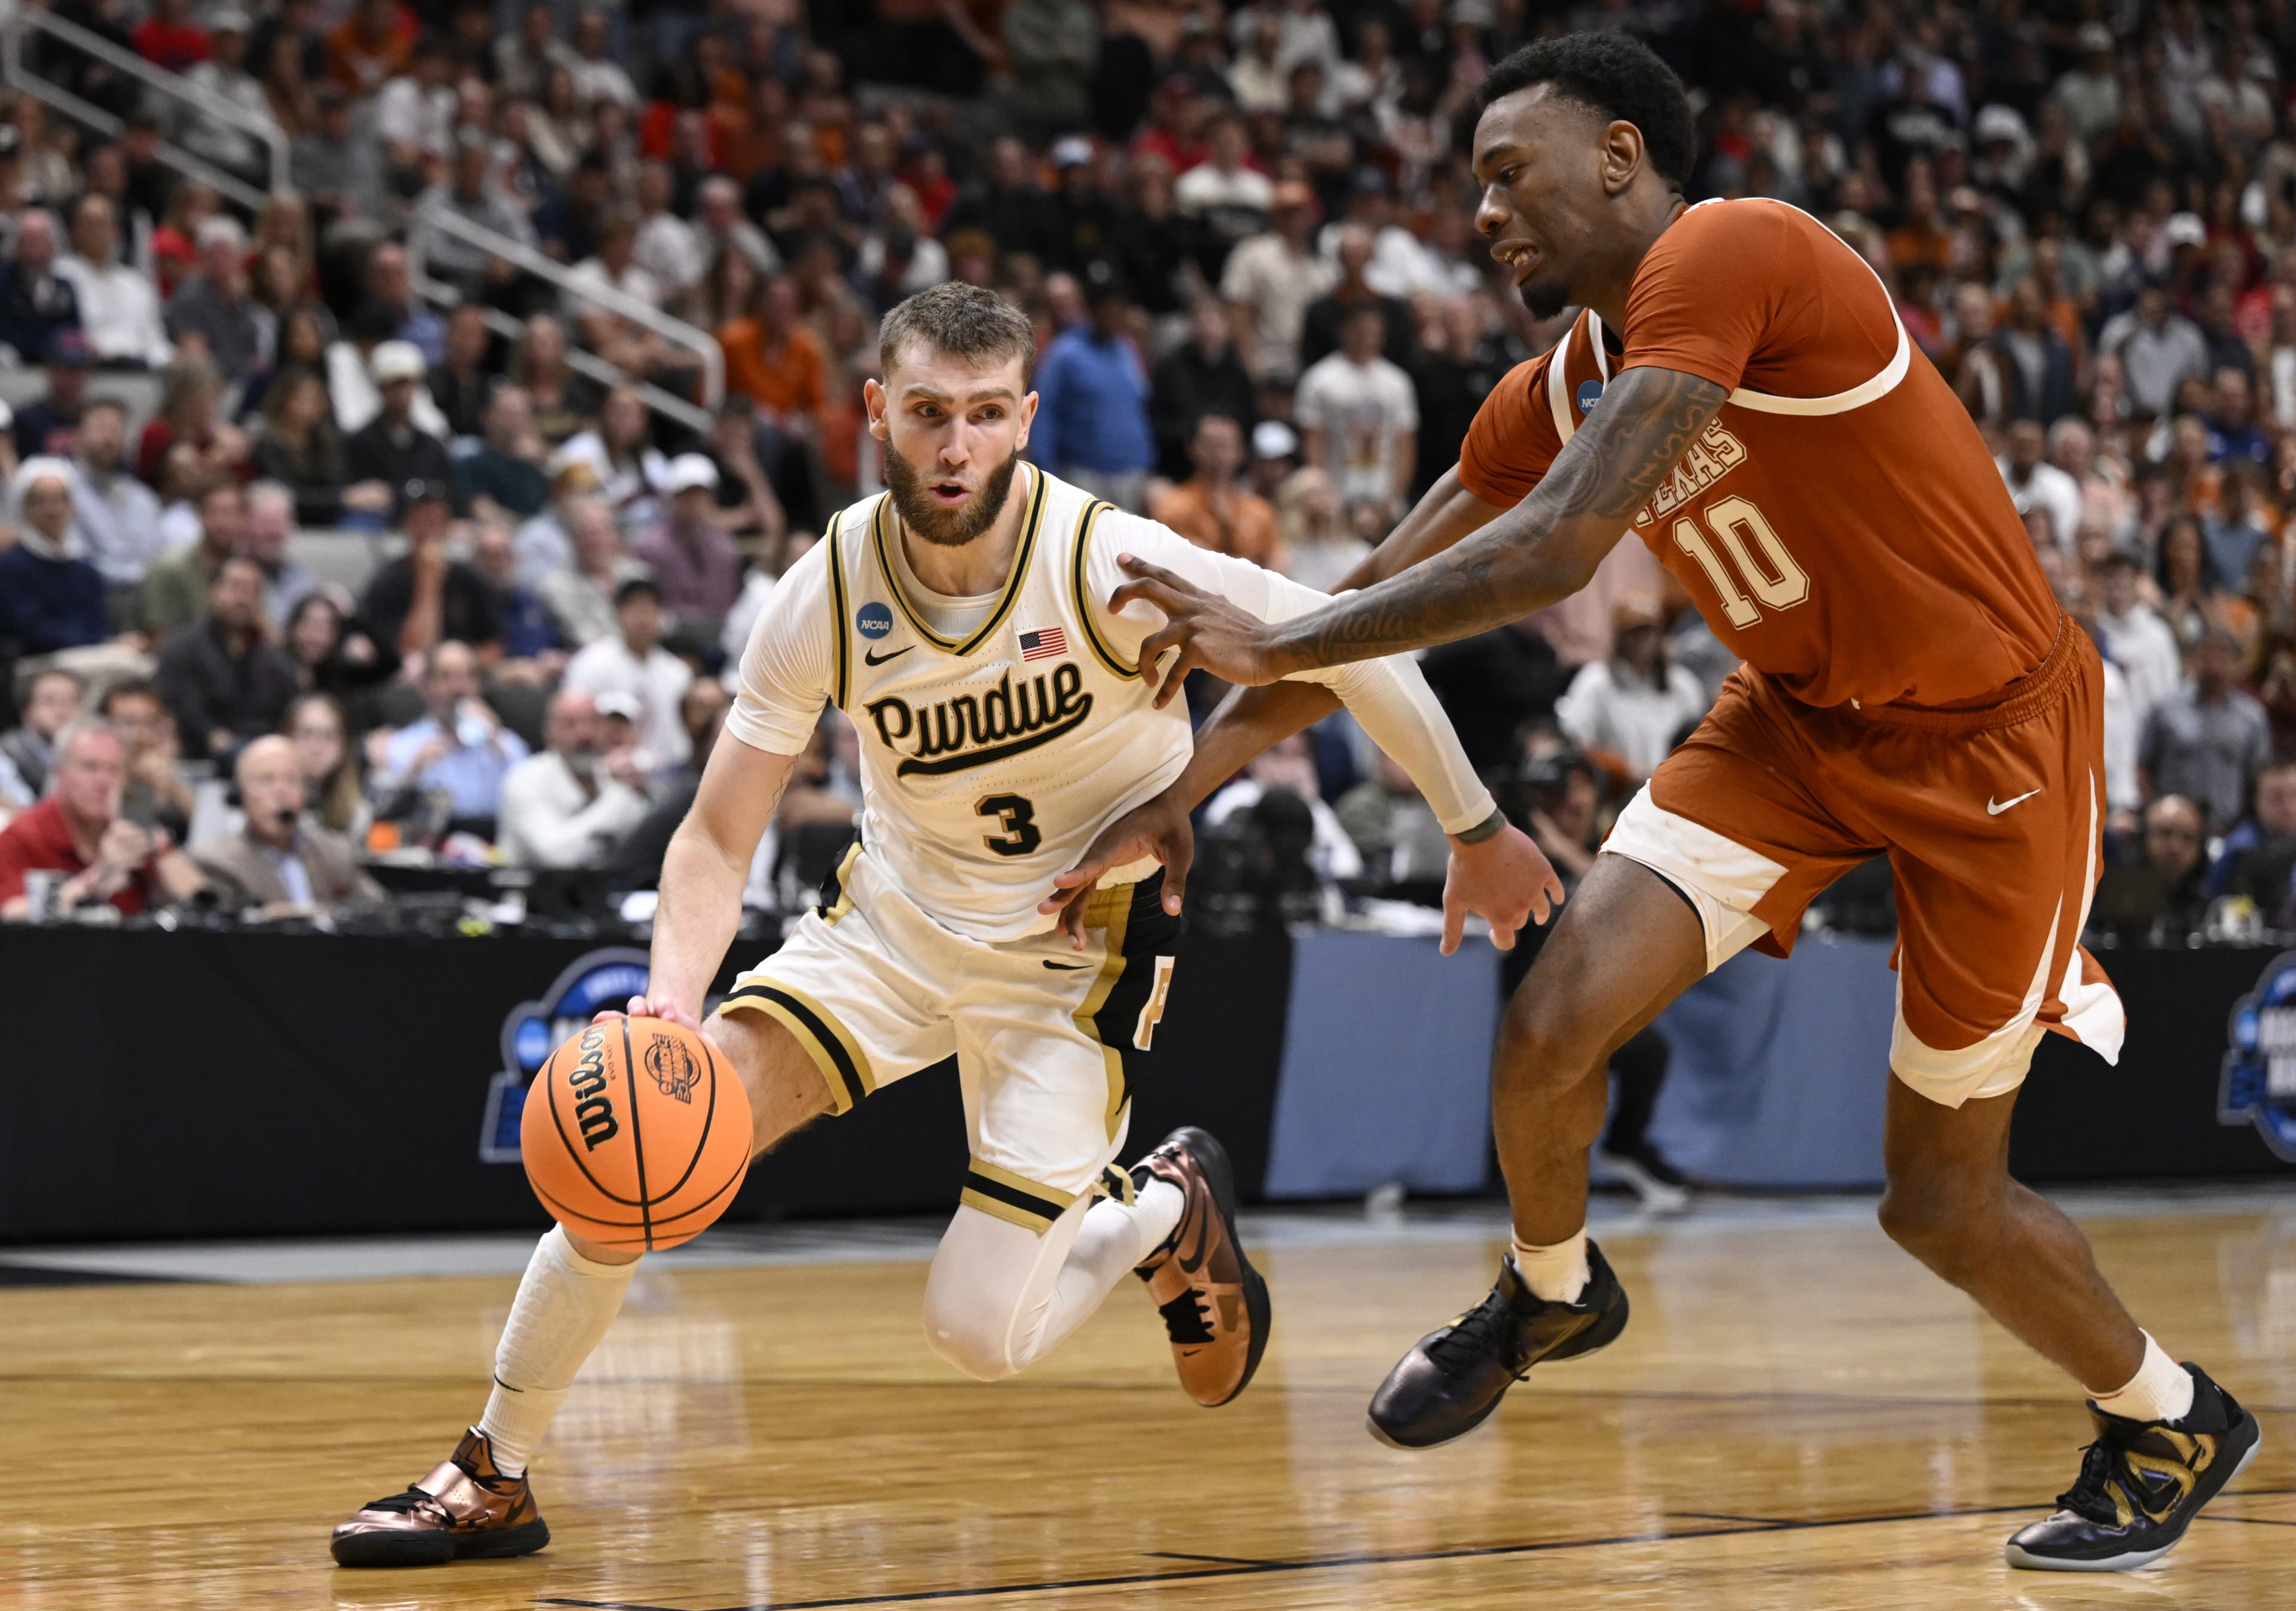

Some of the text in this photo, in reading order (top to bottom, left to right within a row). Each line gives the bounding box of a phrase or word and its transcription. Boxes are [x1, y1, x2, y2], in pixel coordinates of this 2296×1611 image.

[1581, 398, 1600, 408] NC
[1634, 416, 1747, 527] EXAS
[1673, 494, 1810, 630] 10
[861, 620, 889, 630] NCAA
[863, 662, 1083, 758] Purdue
[975, 792, 1042, 856] 3
[569, 1023, 619, 1153] Wilson
